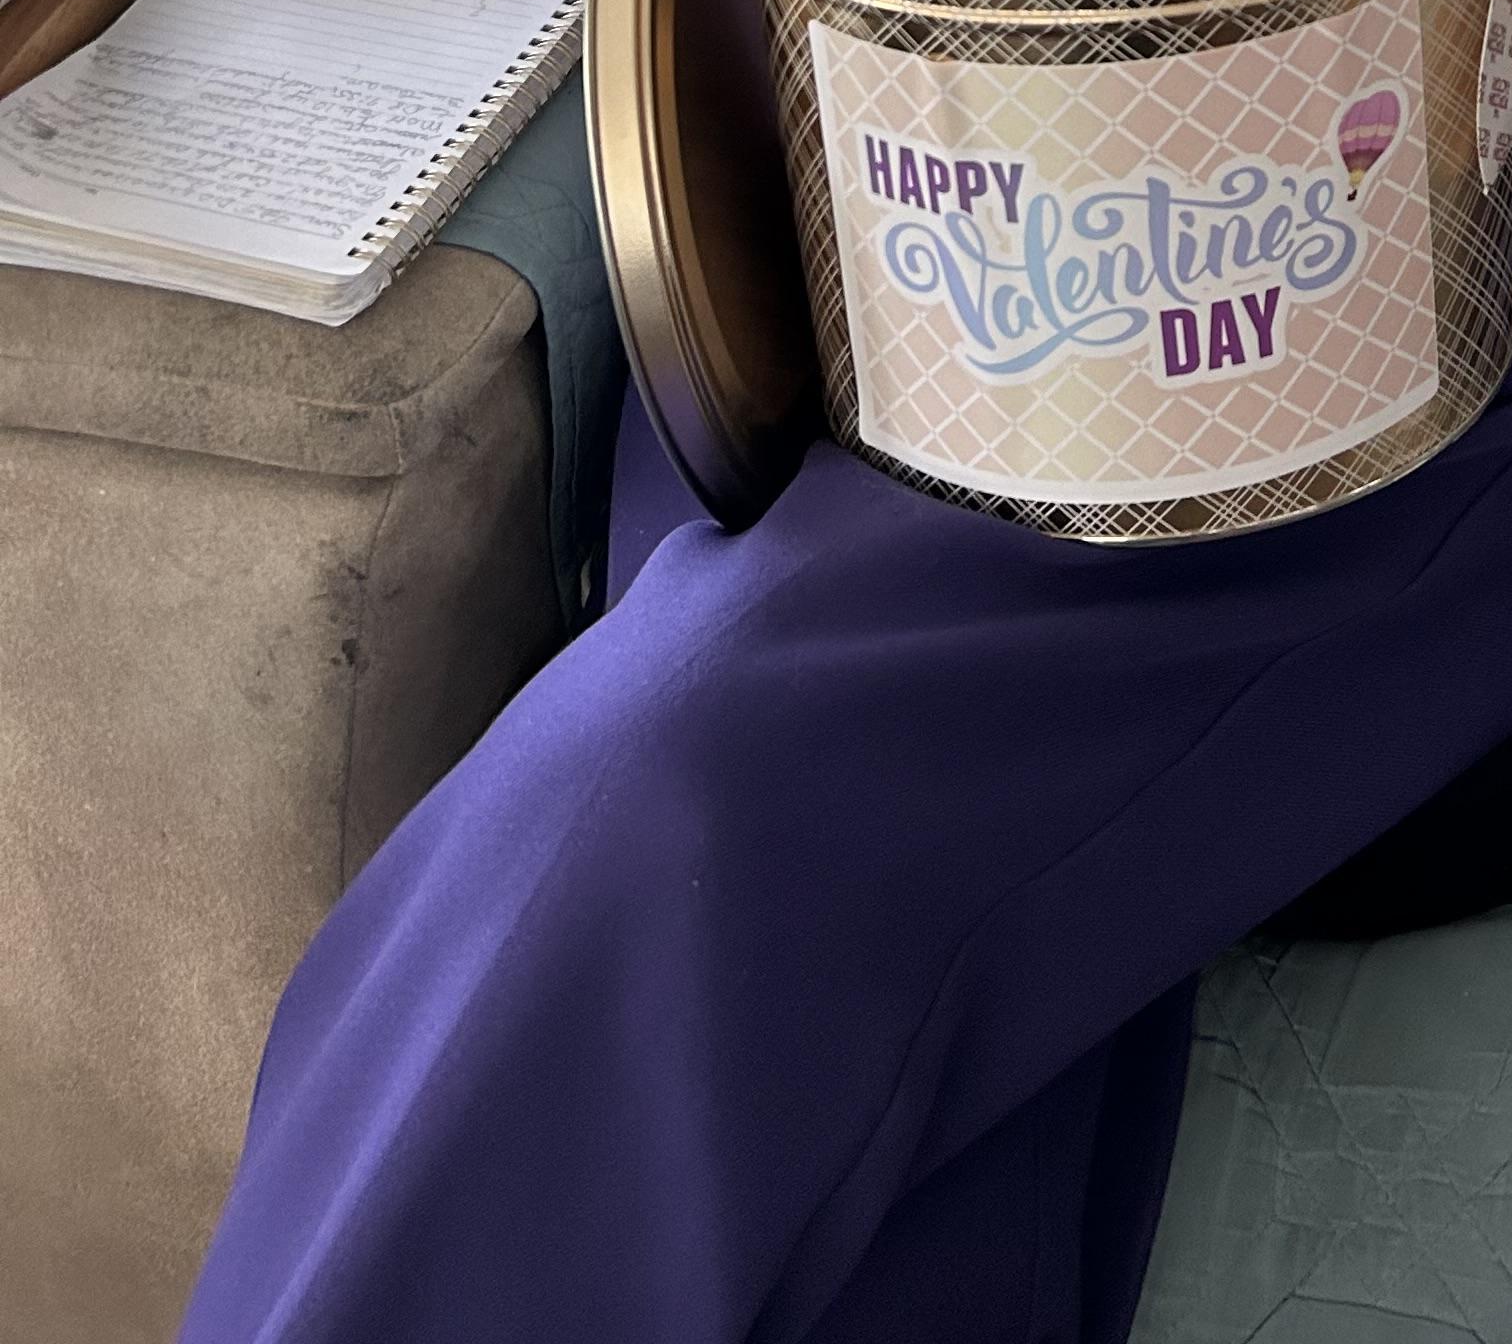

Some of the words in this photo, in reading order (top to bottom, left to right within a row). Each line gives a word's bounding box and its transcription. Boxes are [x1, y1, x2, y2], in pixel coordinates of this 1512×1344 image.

[865, 134, 1024, 223] HAPPY
[885, 166, 1356, 373] Valentine's
[1161, 286, 1281, 376] DAY
